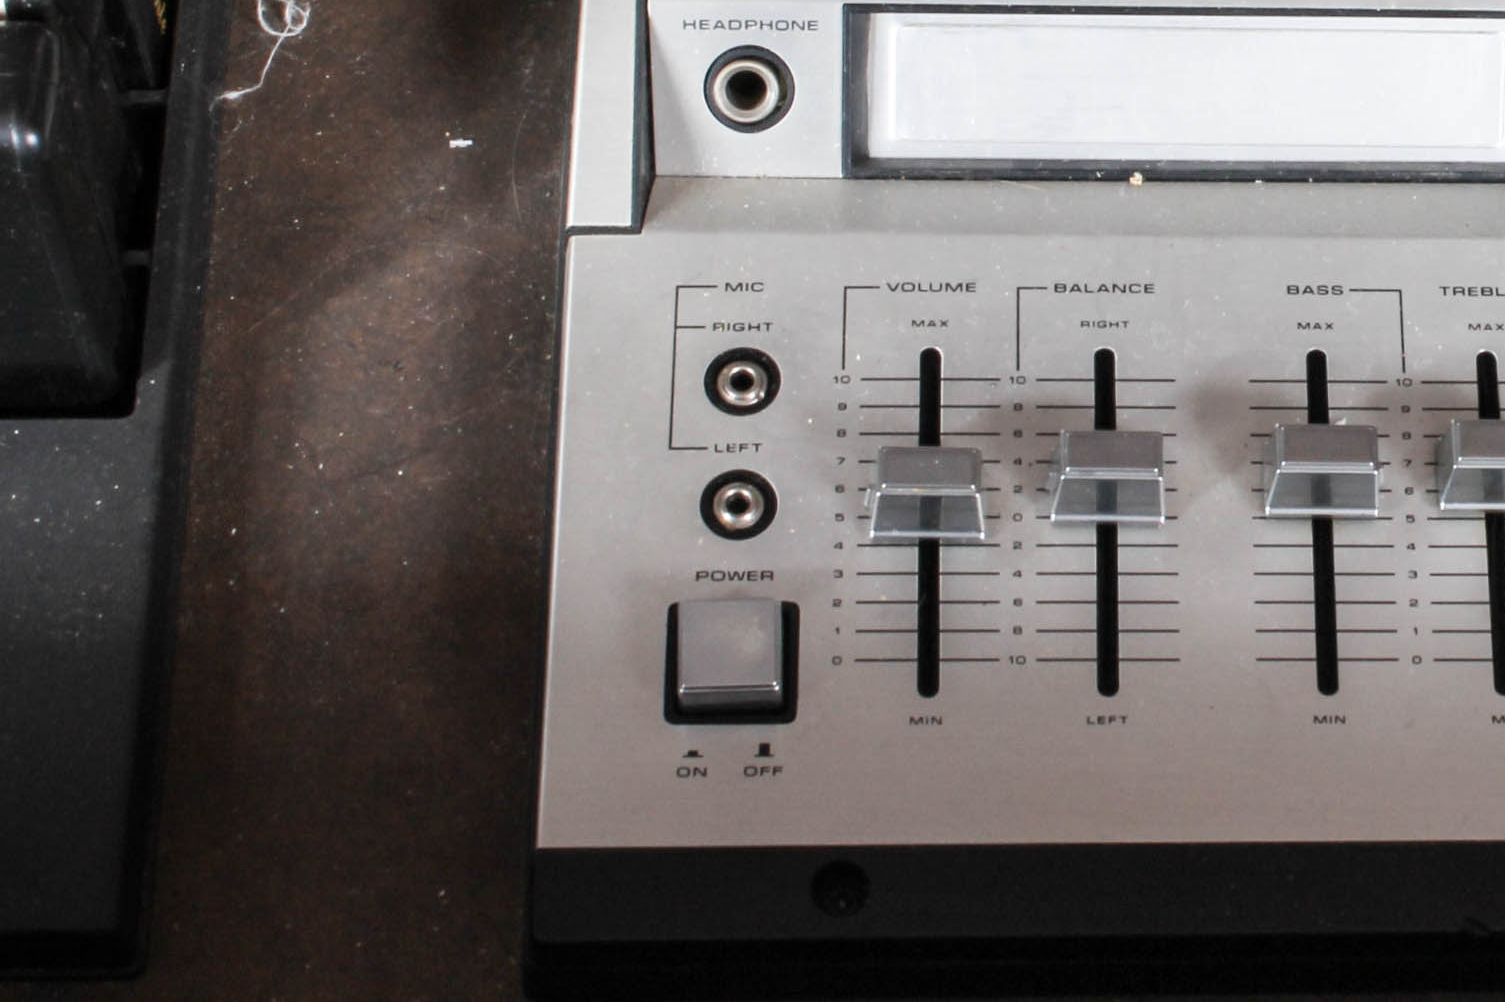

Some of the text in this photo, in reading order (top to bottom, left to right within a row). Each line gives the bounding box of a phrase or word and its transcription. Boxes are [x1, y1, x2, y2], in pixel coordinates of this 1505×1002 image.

[682, 19, 819, 32] HEADPHONE
[724, 281, 764, 293] MIC
[886, 281, 977, 293] VOLUME
[1053, 282, 1155, 294] BALANCE
[1286, 284, 1344, 296] BASS
[712, 321, 774, 333] RIGHT
[911, 319, 949, 328] MAX
[1080, 319, 1129, 329] RIGHT
[1296, 321, 1334, 330] MAX
[1467, 323, 1505, 331] MAX
[833, 374, 852, 385] 10
[1008, 375, 1027, 386] 10
[1395, 377, 1414, 389] 10
[837, 402, 848, 412] 9
[1012, 402, 1025, 413] 8
[1400, 404, 1411, 414] 9
[836, 428, 847, 438] 8
[1012, 429, 1024, 439] 6
[1401, 431, 1412, 441] 8
[714, 442, 762, 454] LEFT
[836, 456, 846, 466] 7
[1012, 457, 1023, 466] 4
[1403, 458, 1413, 468] 7
[834, 483, 846, 494] 6
[1012, 483, 1024, 495] 2
[1404, 486, 1415, 496] 6
[834, 512, 845, 523] 5
[1011, 512, 1024, 523] 0
[1405, 514, 1416, 524] 5
[833, 541, 844, 551] 4
[1012, 540, 1023, 551] 2
[1406, 542, 1416, 551] 4
[695, 569, 775, 583] POWER
[833, 569, 844, 579] 3
[1011, 569, 1023, 578] 4
[1408, 569, 1418, 580] 3
[831, 598, 843, 608] 2
[1012, 597, 1023, 607] 6
[1408, 598, 1419, 608] 2
[834, 626, 841, 635] 1
[1012, 625, 1023, 636] 8
[1413, 626, 1419, 636] 1
[831, 655, 843, 667] 0
[1008, 654, 1027, 666] 10
[1411, 654, 1423, 666] 0
[908, 715, 943, 726] MIN
[1085, 715, 1128, 726] LEFT
[1312, 714, 1347, 725] MIN
[675, 766, 708, 779] ON
[743, 765, 783, 778] OFF
